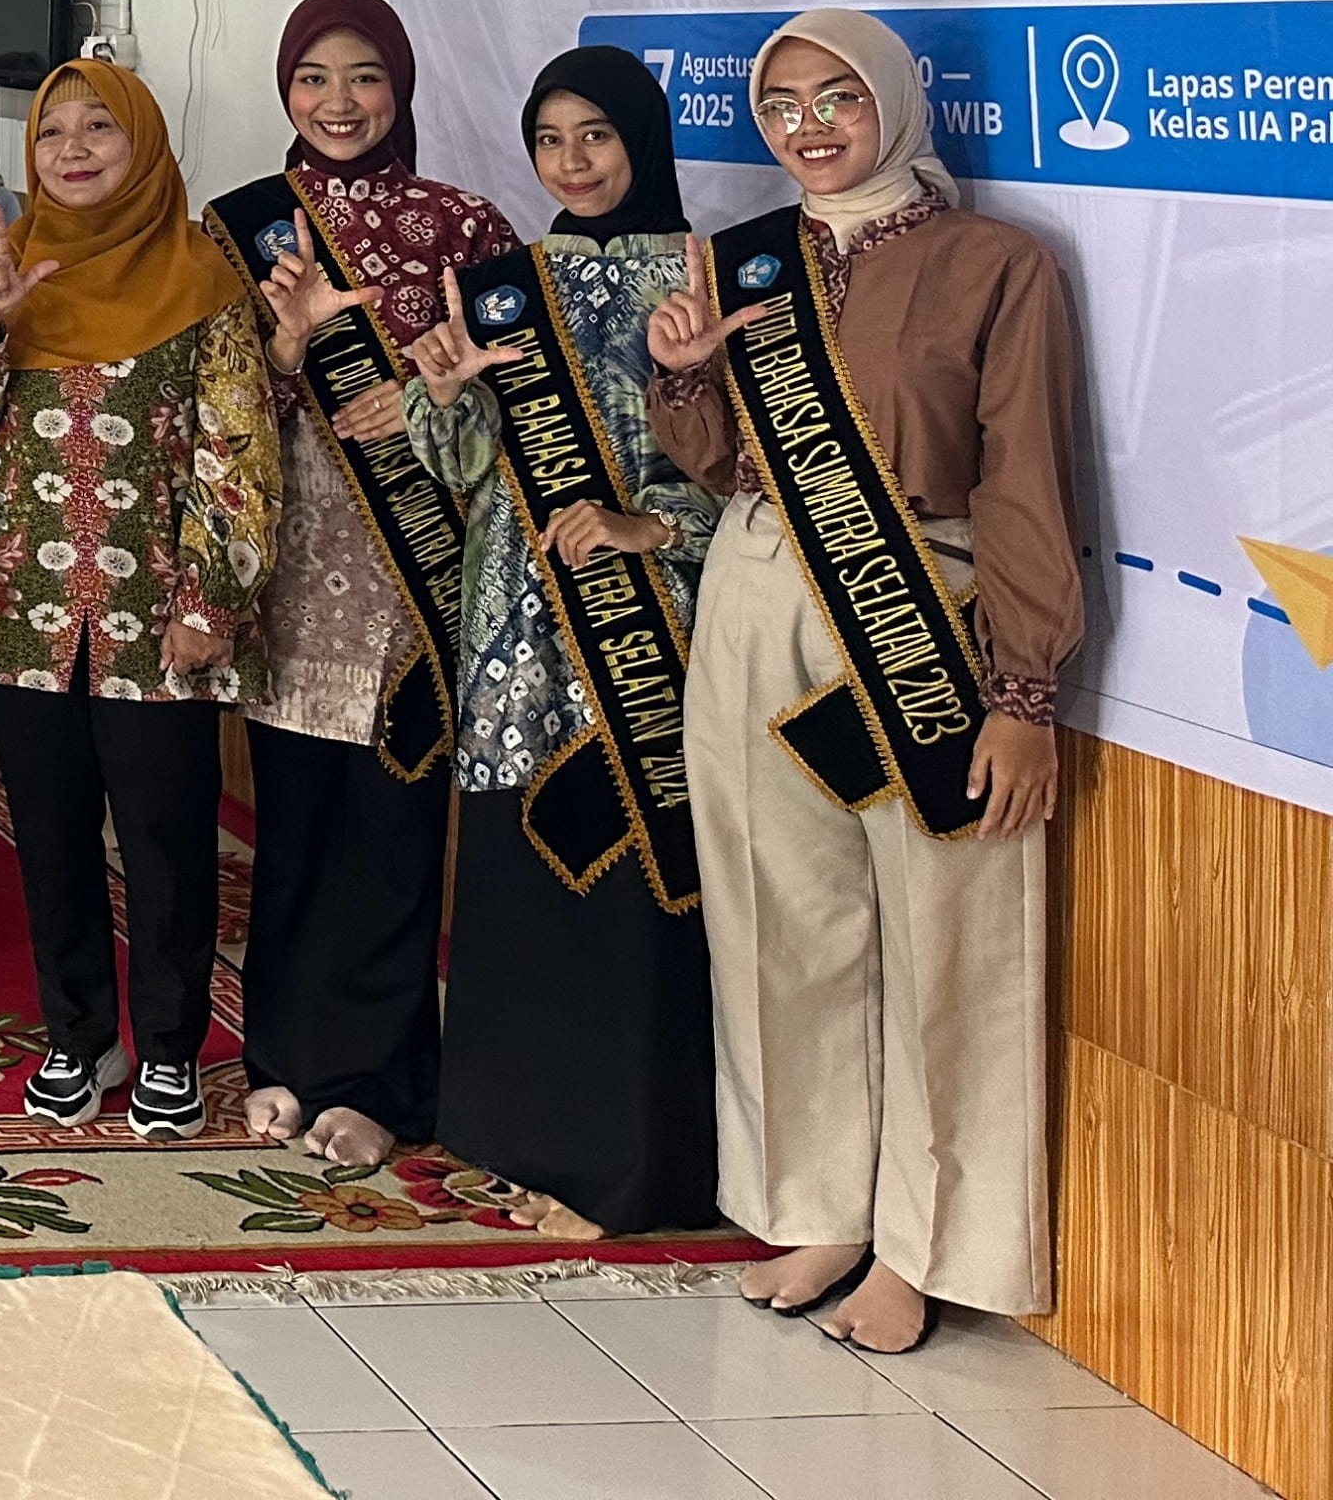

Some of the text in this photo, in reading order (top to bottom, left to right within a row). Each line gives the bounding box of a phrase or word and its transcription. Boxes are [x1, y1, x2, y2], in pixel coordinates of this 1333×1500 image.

[644, 49, 674, 93] 7
[678, 93, 734, 127] 2025
[1147, 68, 1234, 106] Lapas
[941, 101, 1003, 135] WIB
[1149, 108, 1229, 140] Kelas
[1238, 111, 1282, 142] IIA
[749, 343, 831, 451] BAHASA
[325, 357, 384, 407] DUT
[386, 479, 462, 571] SUMATRA
[787, 440, 886, 564] SUMATERA
[509, 394, 591, 497] BAHASA
[599, 630, 684, 742] SELATAN
[839, 554, 941, 676] SELATAN
[886, 666, 972, 745] 2023
